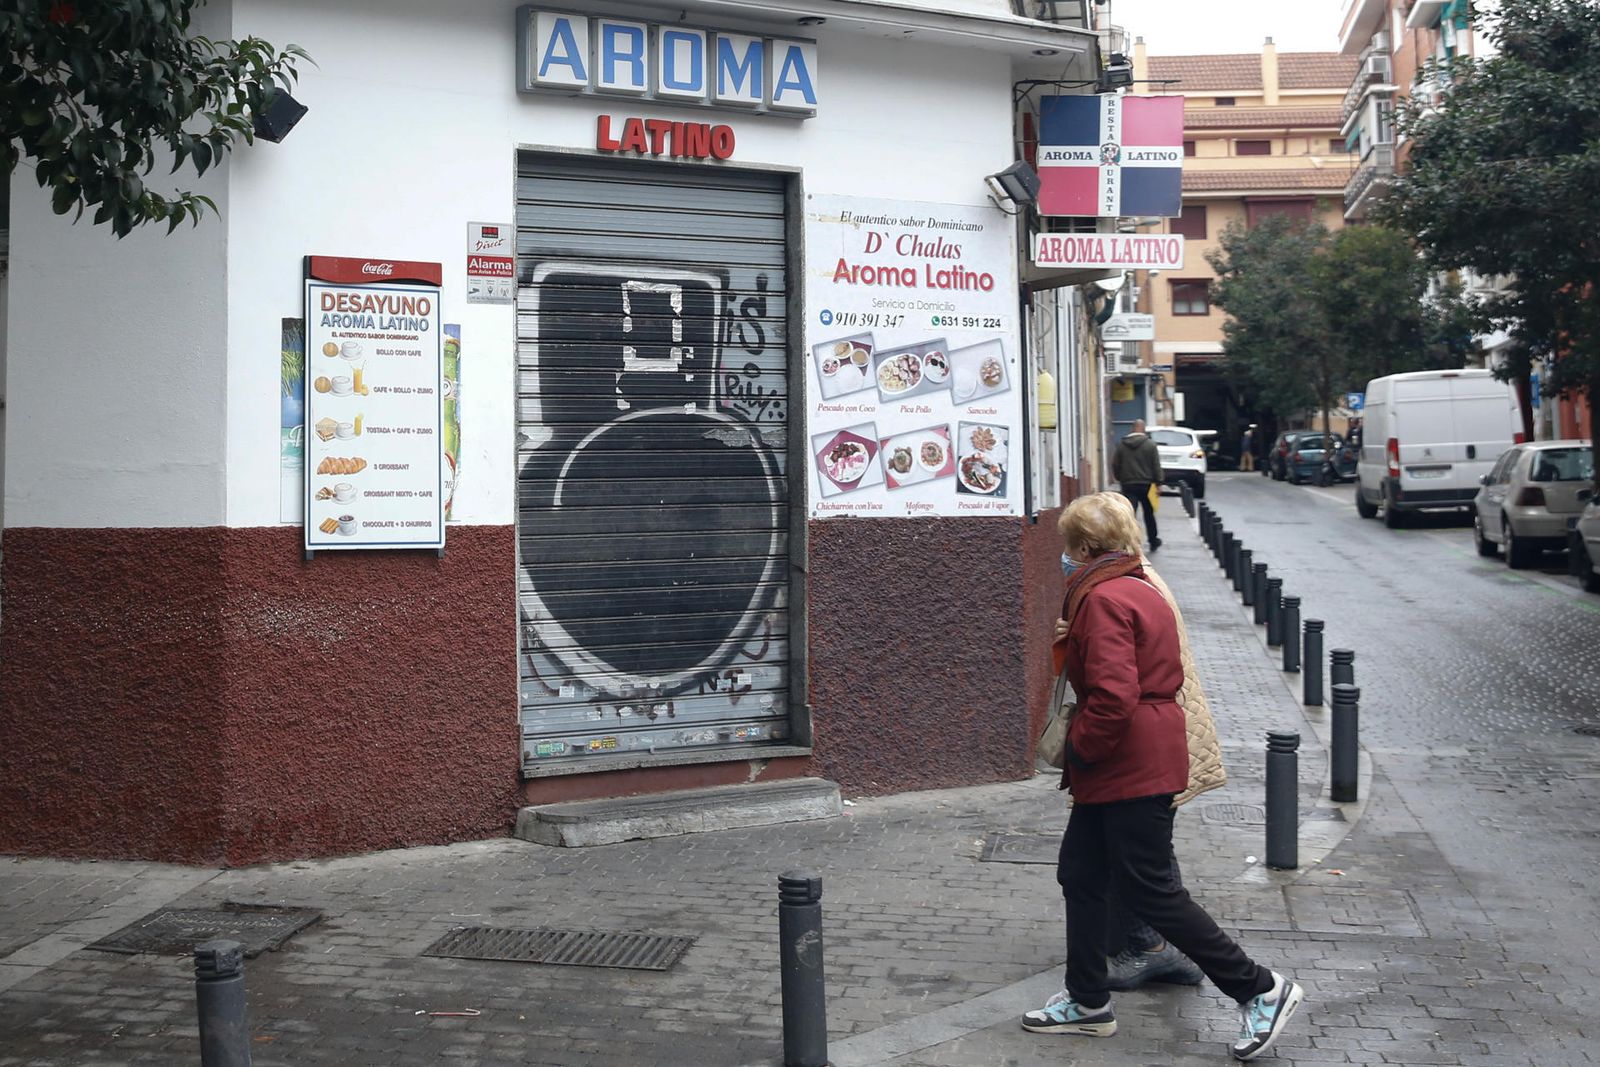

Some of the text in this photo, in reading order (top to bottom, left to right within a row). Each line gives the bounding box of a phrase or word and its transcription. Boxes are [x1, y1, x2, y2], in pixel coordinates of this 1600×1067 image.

[538, 18, 817, 104] AROMA
[597, 115, 736, 160] LATINO
[1044, 151, 1177, 161] AROMA LATINO
[840, 210, 984, 232] El autentico sabor Dominicano
[896, 233, 962, 260] Chalas
[1038, 237, 1180, 264] AROMA LATINO
[468, 258, 512, 270] Alarma
[833, 258, 994, 292] Aroma Latino
[321, 292, 431, 316] DESAYUNO
[872, 298, 905, 310] Servicio
[917, 300, 956, 312] Domicilio
[320, 313, 429, 332] AROMA LATINO
[835, 312, 904, 328] 910 391 347
[941, 316, 1001, 328] 631 591 224
[817, 404, 844, 412] Pescado
[858, 404, 876, 412] Coco
[905, 502, 934, 512] Mofongo
